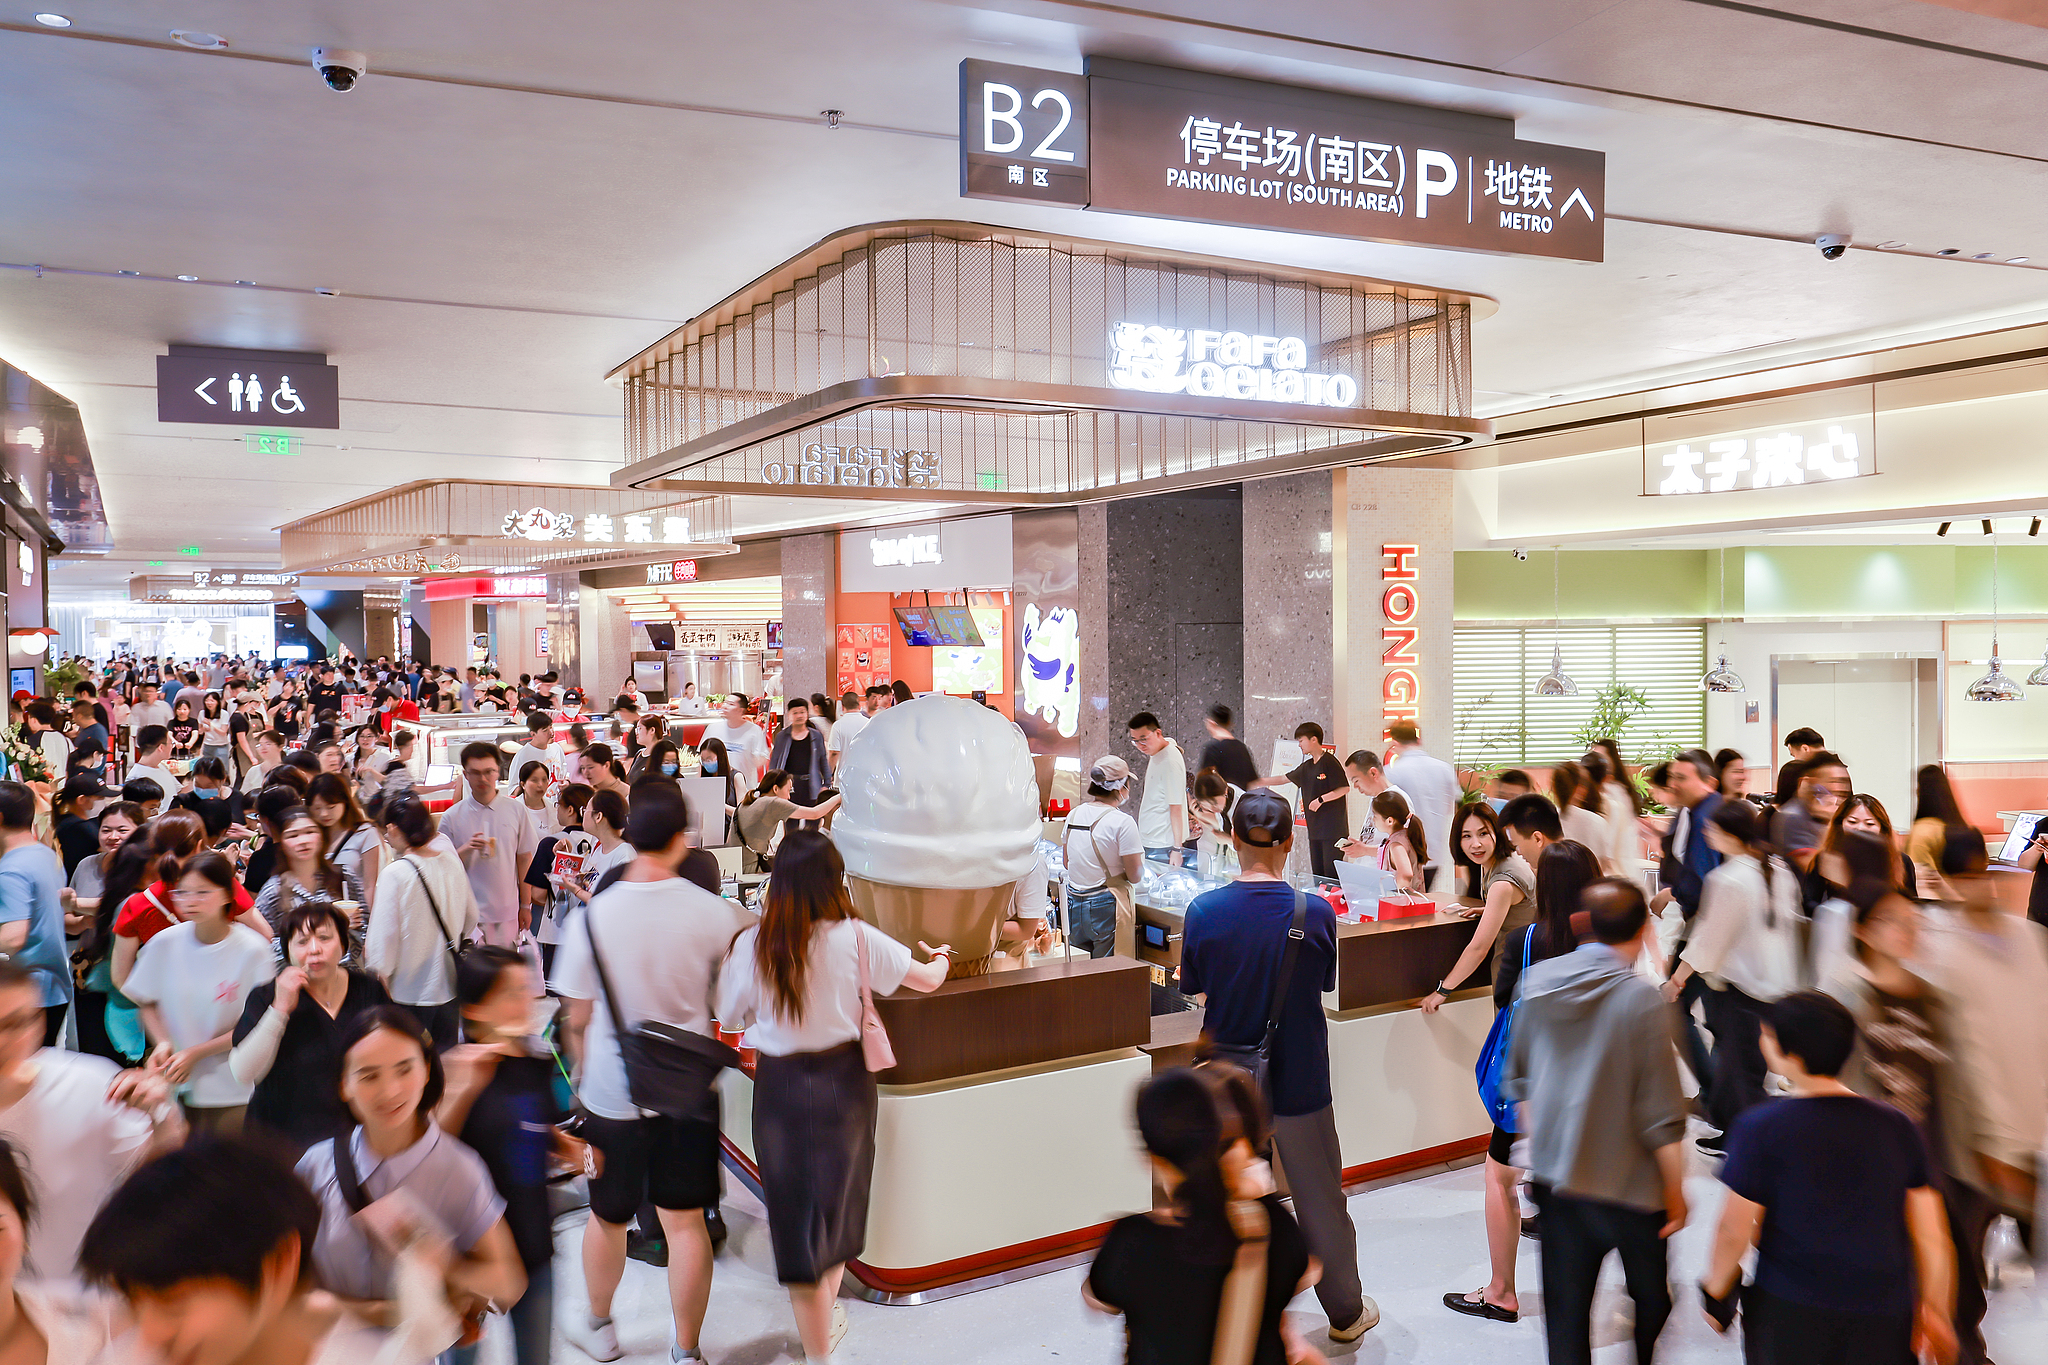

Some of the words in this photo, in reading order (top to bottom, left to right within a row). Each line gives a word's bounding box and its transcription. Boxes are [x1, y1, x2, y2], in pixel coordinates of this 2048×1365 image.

[983, 81, 1075, 162] B2
[1008, 165, 1049, 187] 南区
[1180, 115, 1406, 196] 停车场(南区)
[1166, 168, 1247, 195] PARKING
[1250, 178, 1284, 199] LOT
[1287, 181, 1353, 208] (SOUTH
[1355, 190, 1404, 217] AREA)
[1416, 148, 1459, 219] P
[1484, 159, 1553, 211] 地铁
[1500, 211, 1553, 234] METRO
[502, 507, 576, 540] 大丸家
[194, 573, 210, 582] B2
[680, 631, 716, 643] 香菜牛肉
[1382, 544, 1419, 767] HONGH
